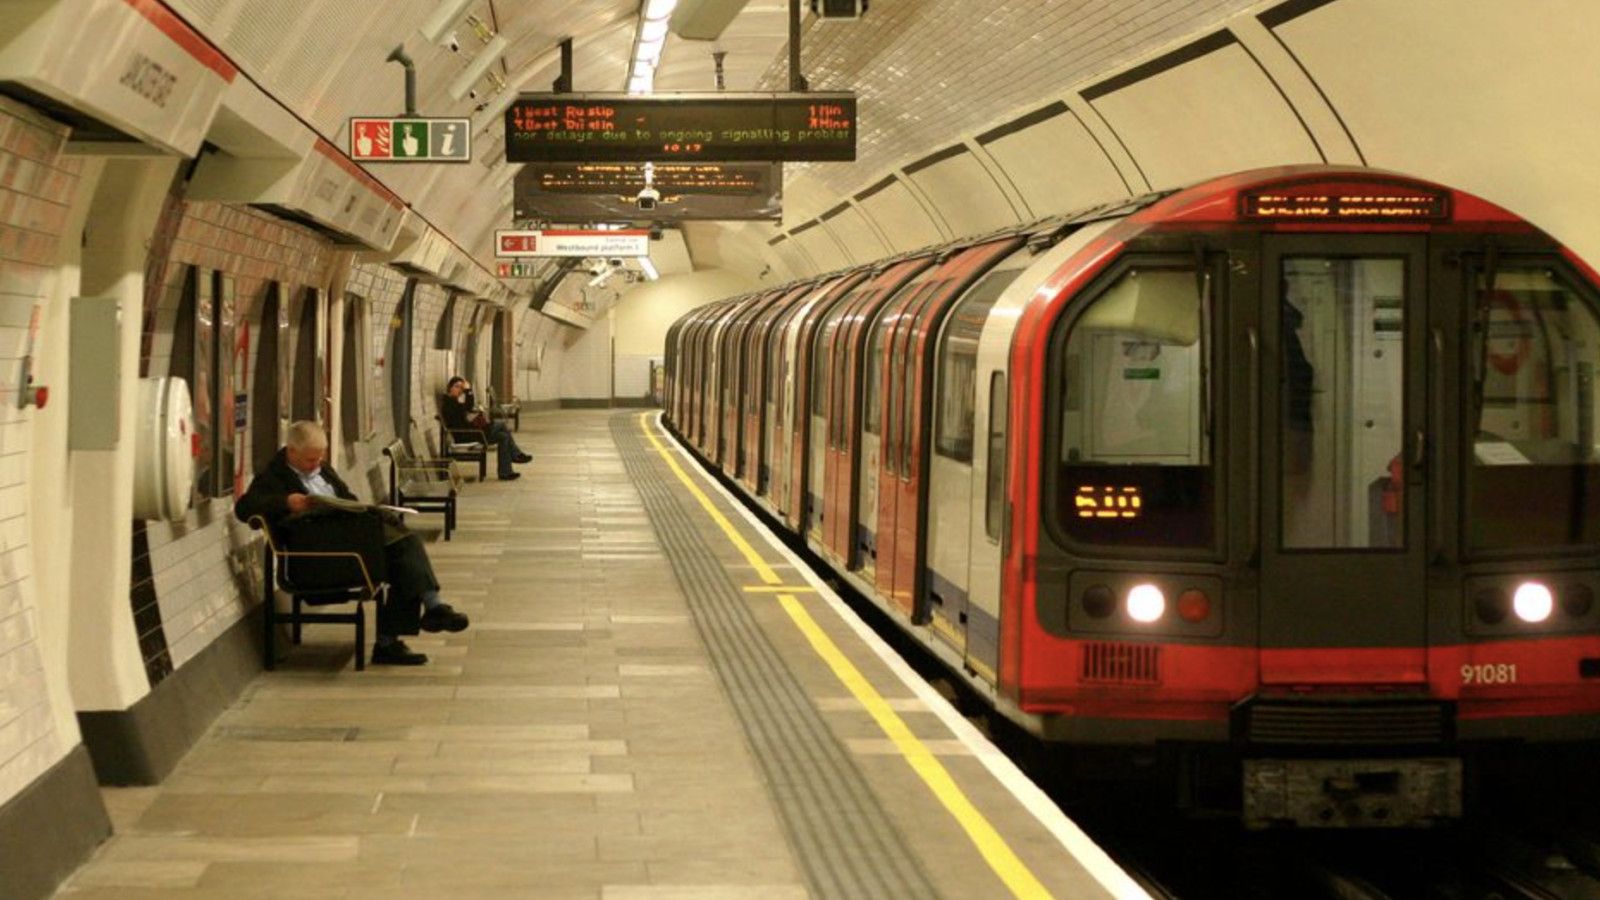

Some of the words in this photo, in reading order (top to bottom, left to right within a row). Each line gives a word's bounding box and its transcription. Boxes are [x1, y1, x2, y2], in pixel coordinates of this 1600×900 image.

[547, 130, 593, 142] delays
[602, 129, 627, 139] due
[636, 129, 650, 139] to
[659, 130, 713, 142] ongoing
[721, 129, 790, 142] signalling
[600, 244, 632, 252] platform
[1460, 663, 1517, 684] 91081
